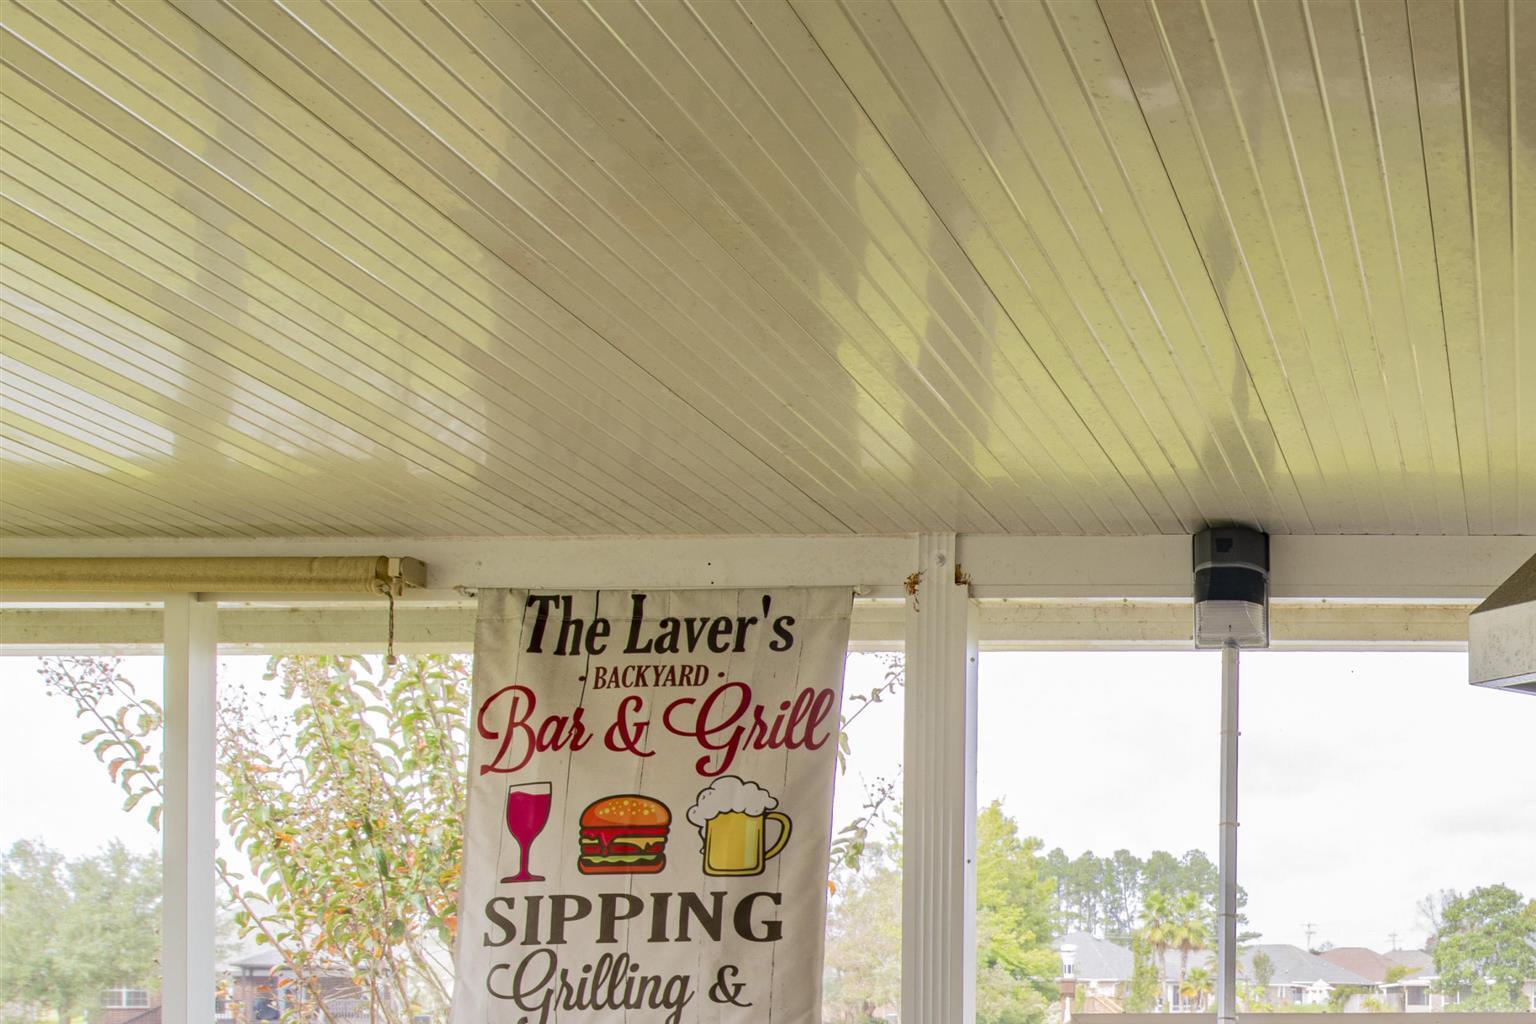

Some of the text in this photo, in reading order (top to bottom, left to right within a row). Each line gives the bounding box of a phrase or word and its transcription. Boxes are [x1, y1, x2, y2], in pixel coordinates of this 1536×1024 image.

[526, 594, 795, 656] The Laver's
[593, 665, 709, 689] BACKYARD
[478, 682, 835, 777] Bar & Grill
[484, 891, 783, 947] SIPPING
[709, 965, 753, 1007] &
